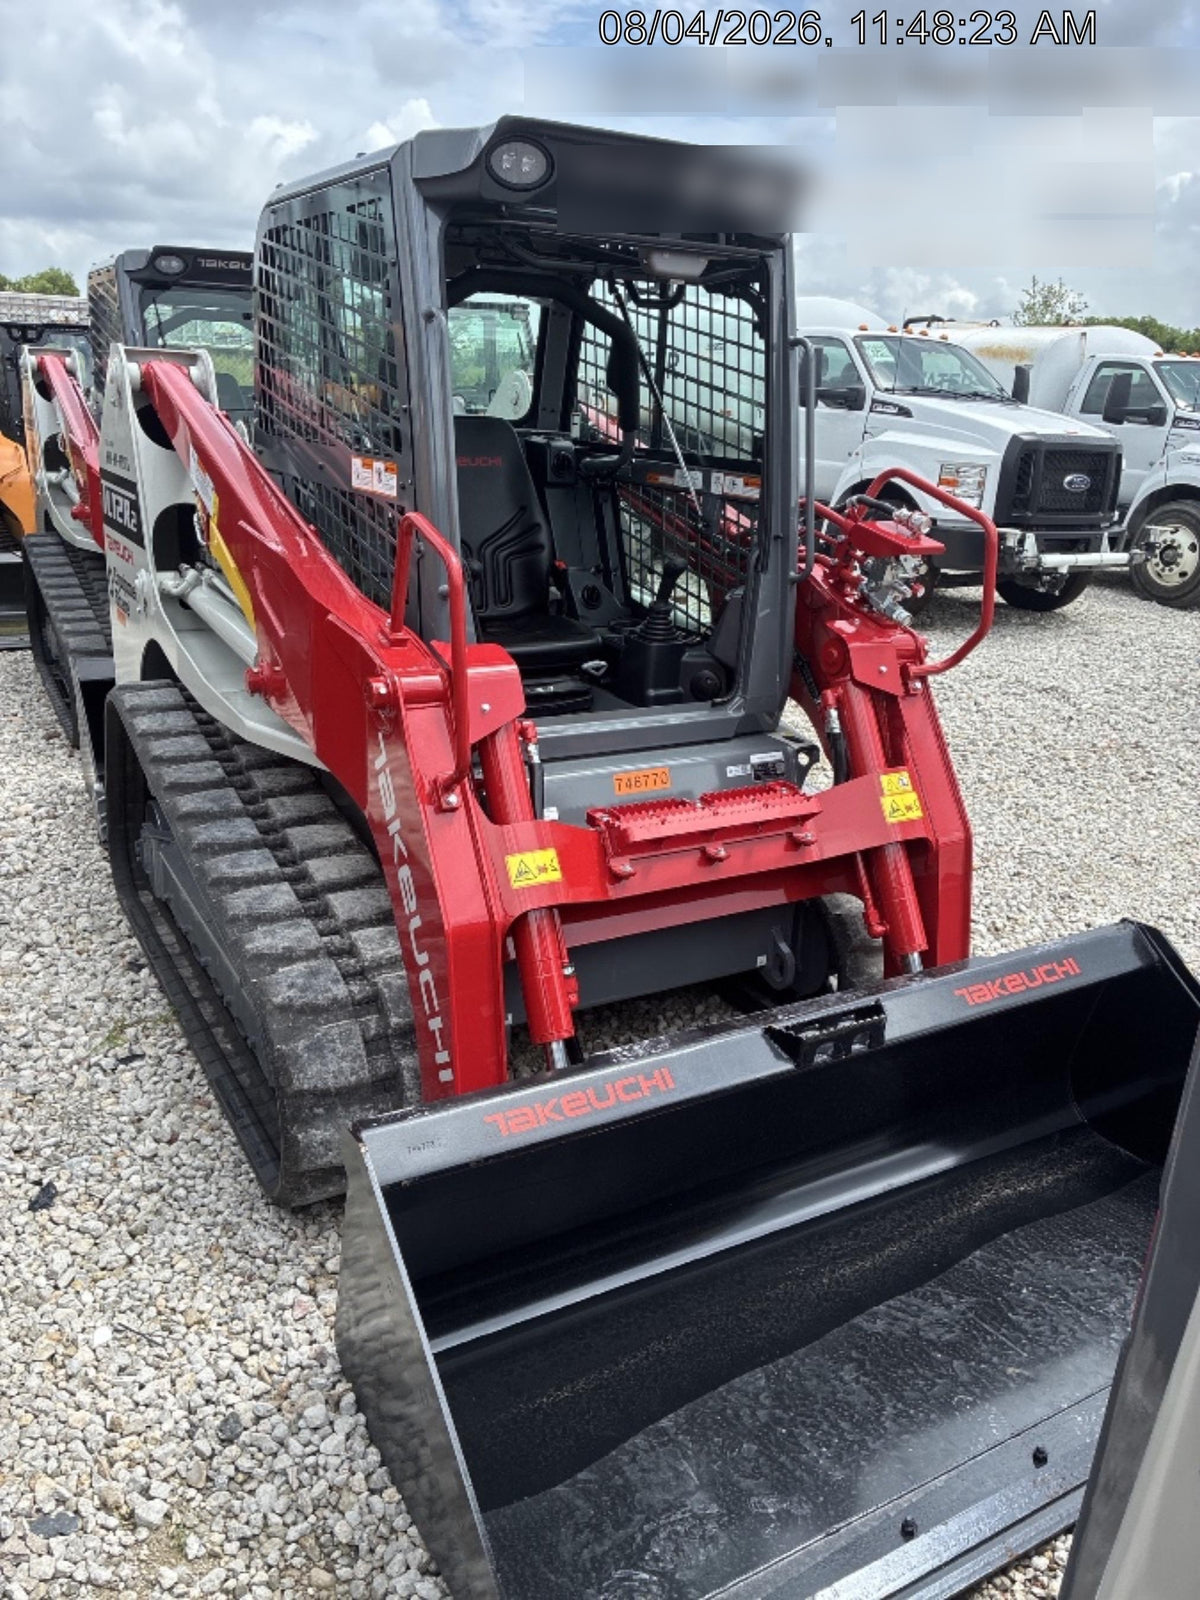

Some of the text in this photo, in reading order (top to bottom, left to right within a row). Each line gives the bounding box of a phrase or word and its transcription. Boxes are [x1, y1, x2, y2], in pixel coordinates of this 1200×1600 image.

[197, 256, 254, 271] TAKEU
[457, 455, 502, 468] EUCHI
[374, 731, 454, 1083] TAKEUCHI
[953, 957, 1083, 1007] TAKEUCHI
[483, 1066, 676, 1137] TAKEUCHI
